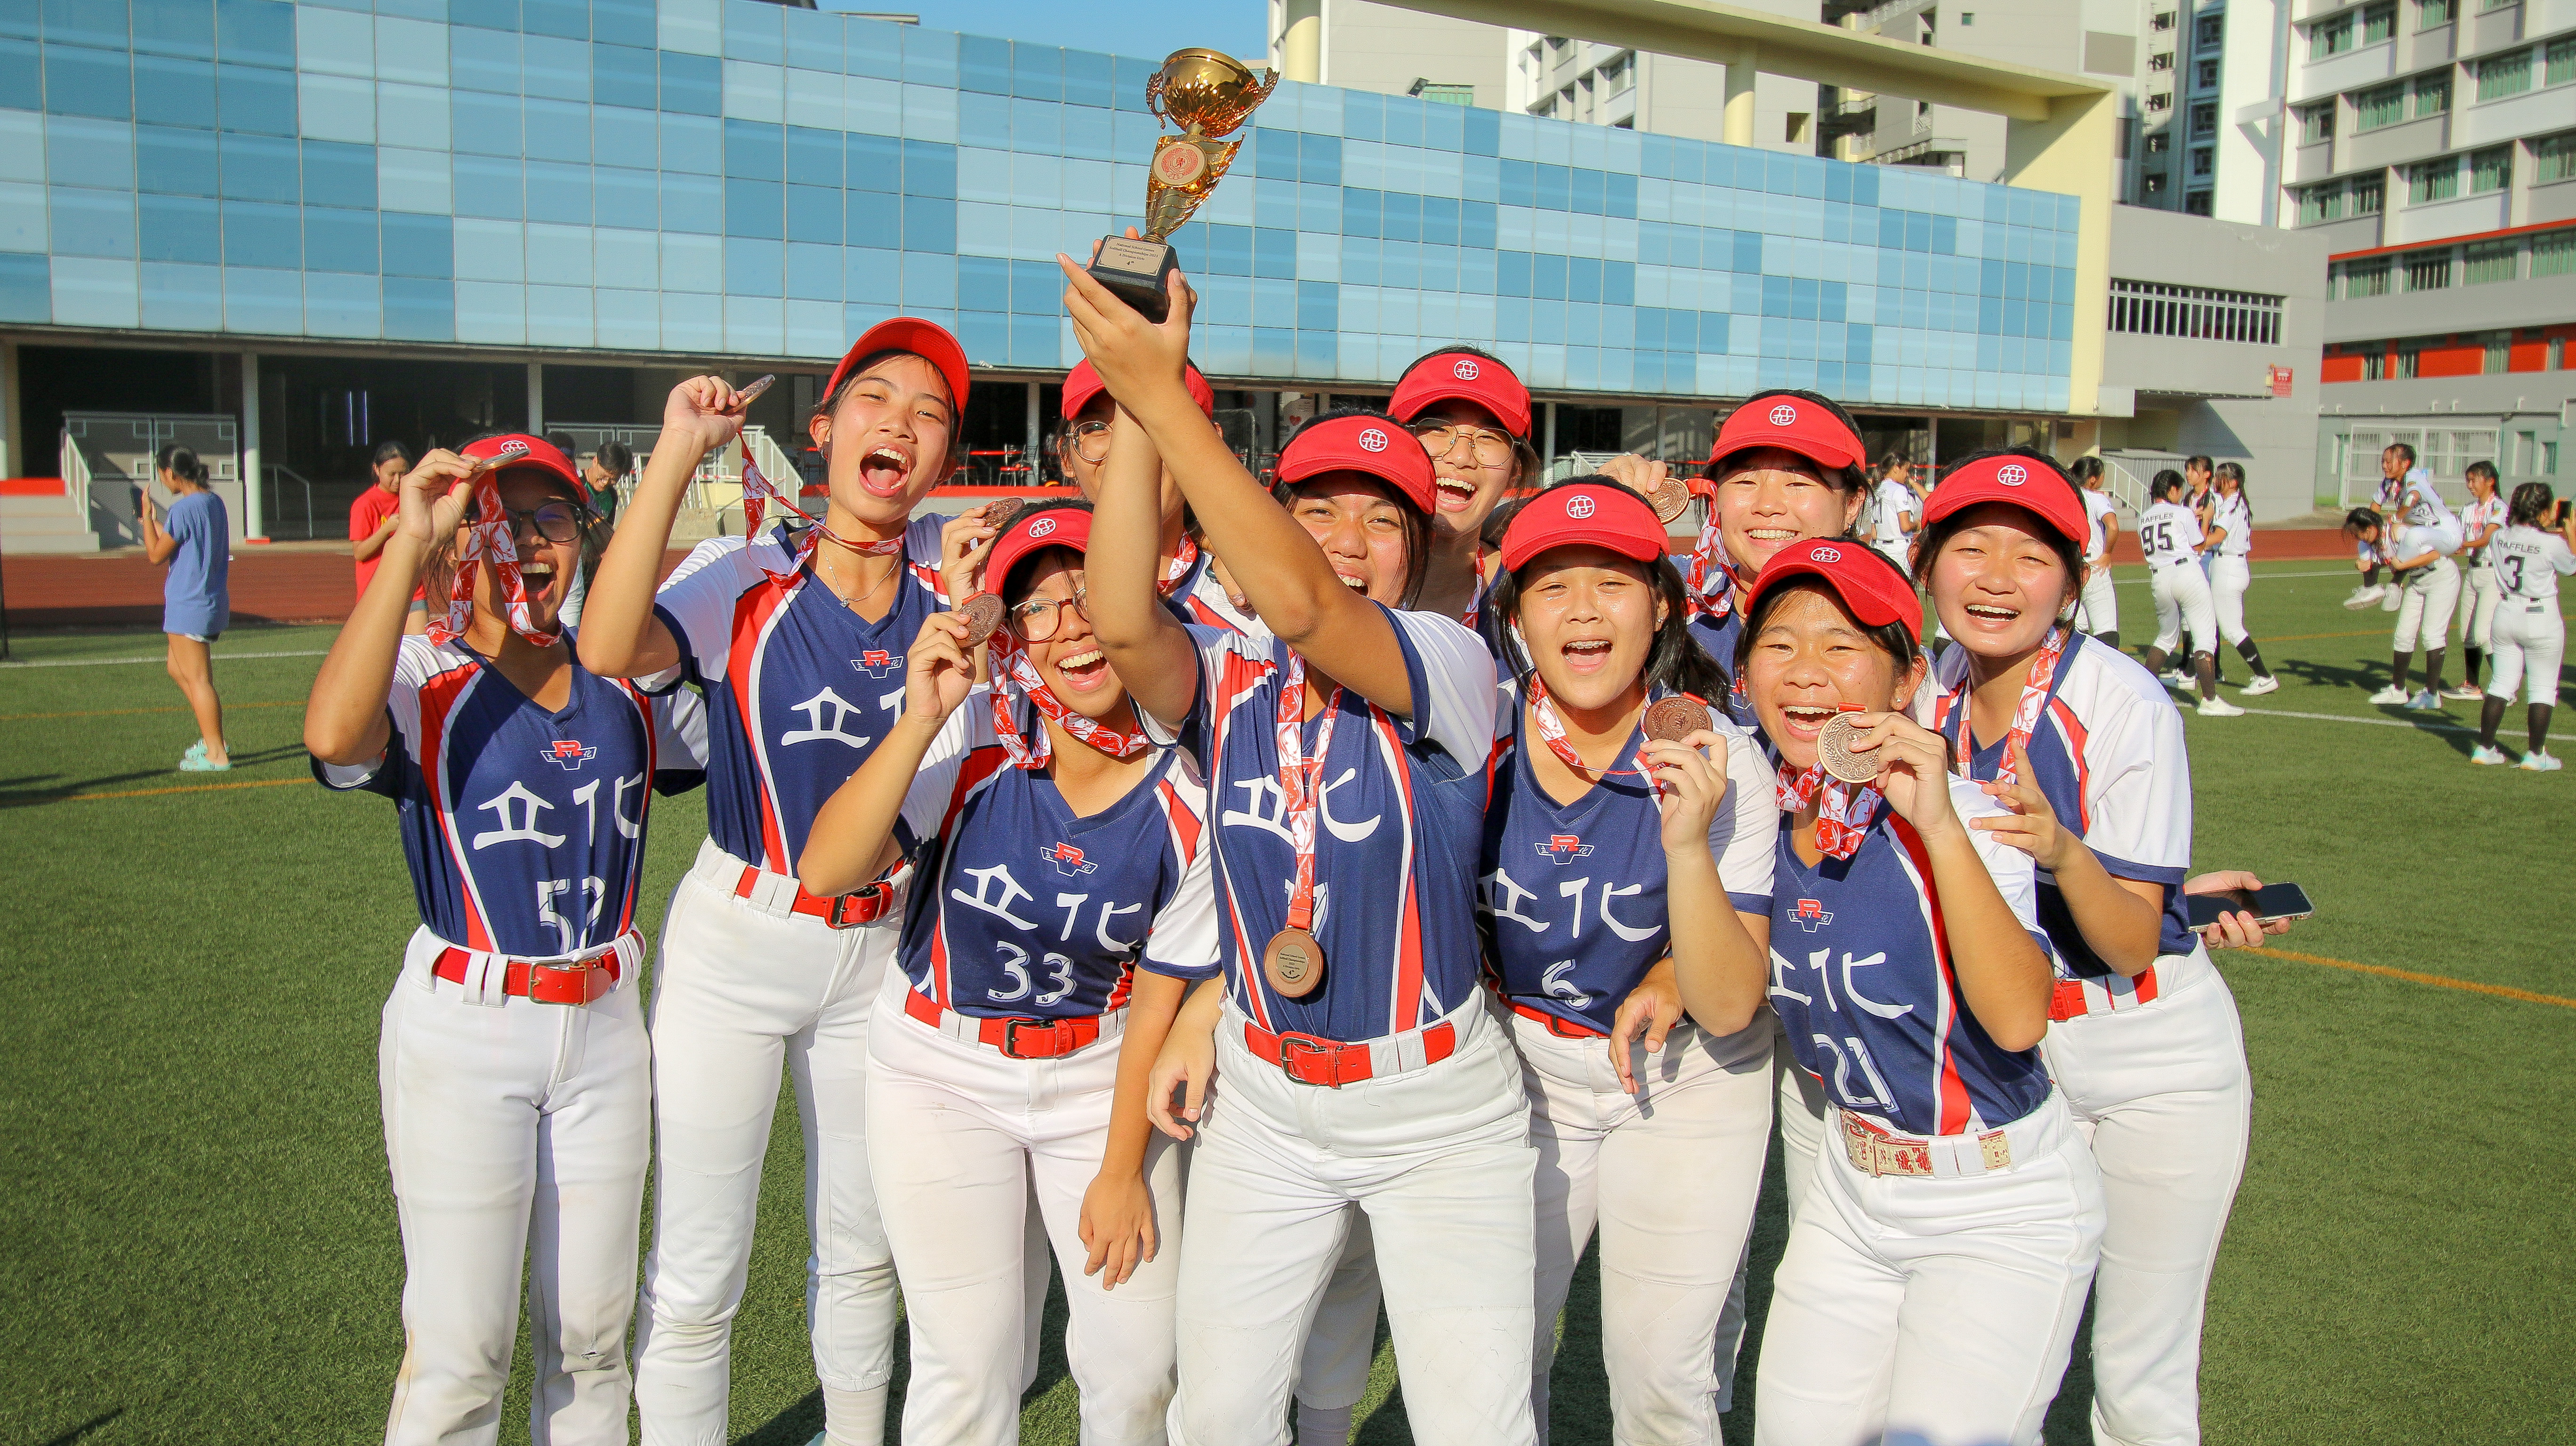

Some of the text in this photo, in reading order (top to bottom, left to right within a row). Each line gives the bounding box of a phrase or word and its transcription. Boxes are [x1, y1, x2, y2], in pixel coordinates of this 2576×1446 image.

[2140, 512, 2174, 524] RAFFLES
[2141, 522, 2174, 557] 95
[2498, 538, 2541, 555] RAFFLES
[2504, 555, 2525, 592] 3
[473, 772, 643, 851] 立化
[537, 876, 606, 955] 52
[950, 863, 1143, 952] 立化
[1477, 867, 1663, 941] 立化
[987, 940, 1078, 1004] 33
[1541, 959, 1593, 1011] 6
[1812, 1033, 1900, 1113] 21
